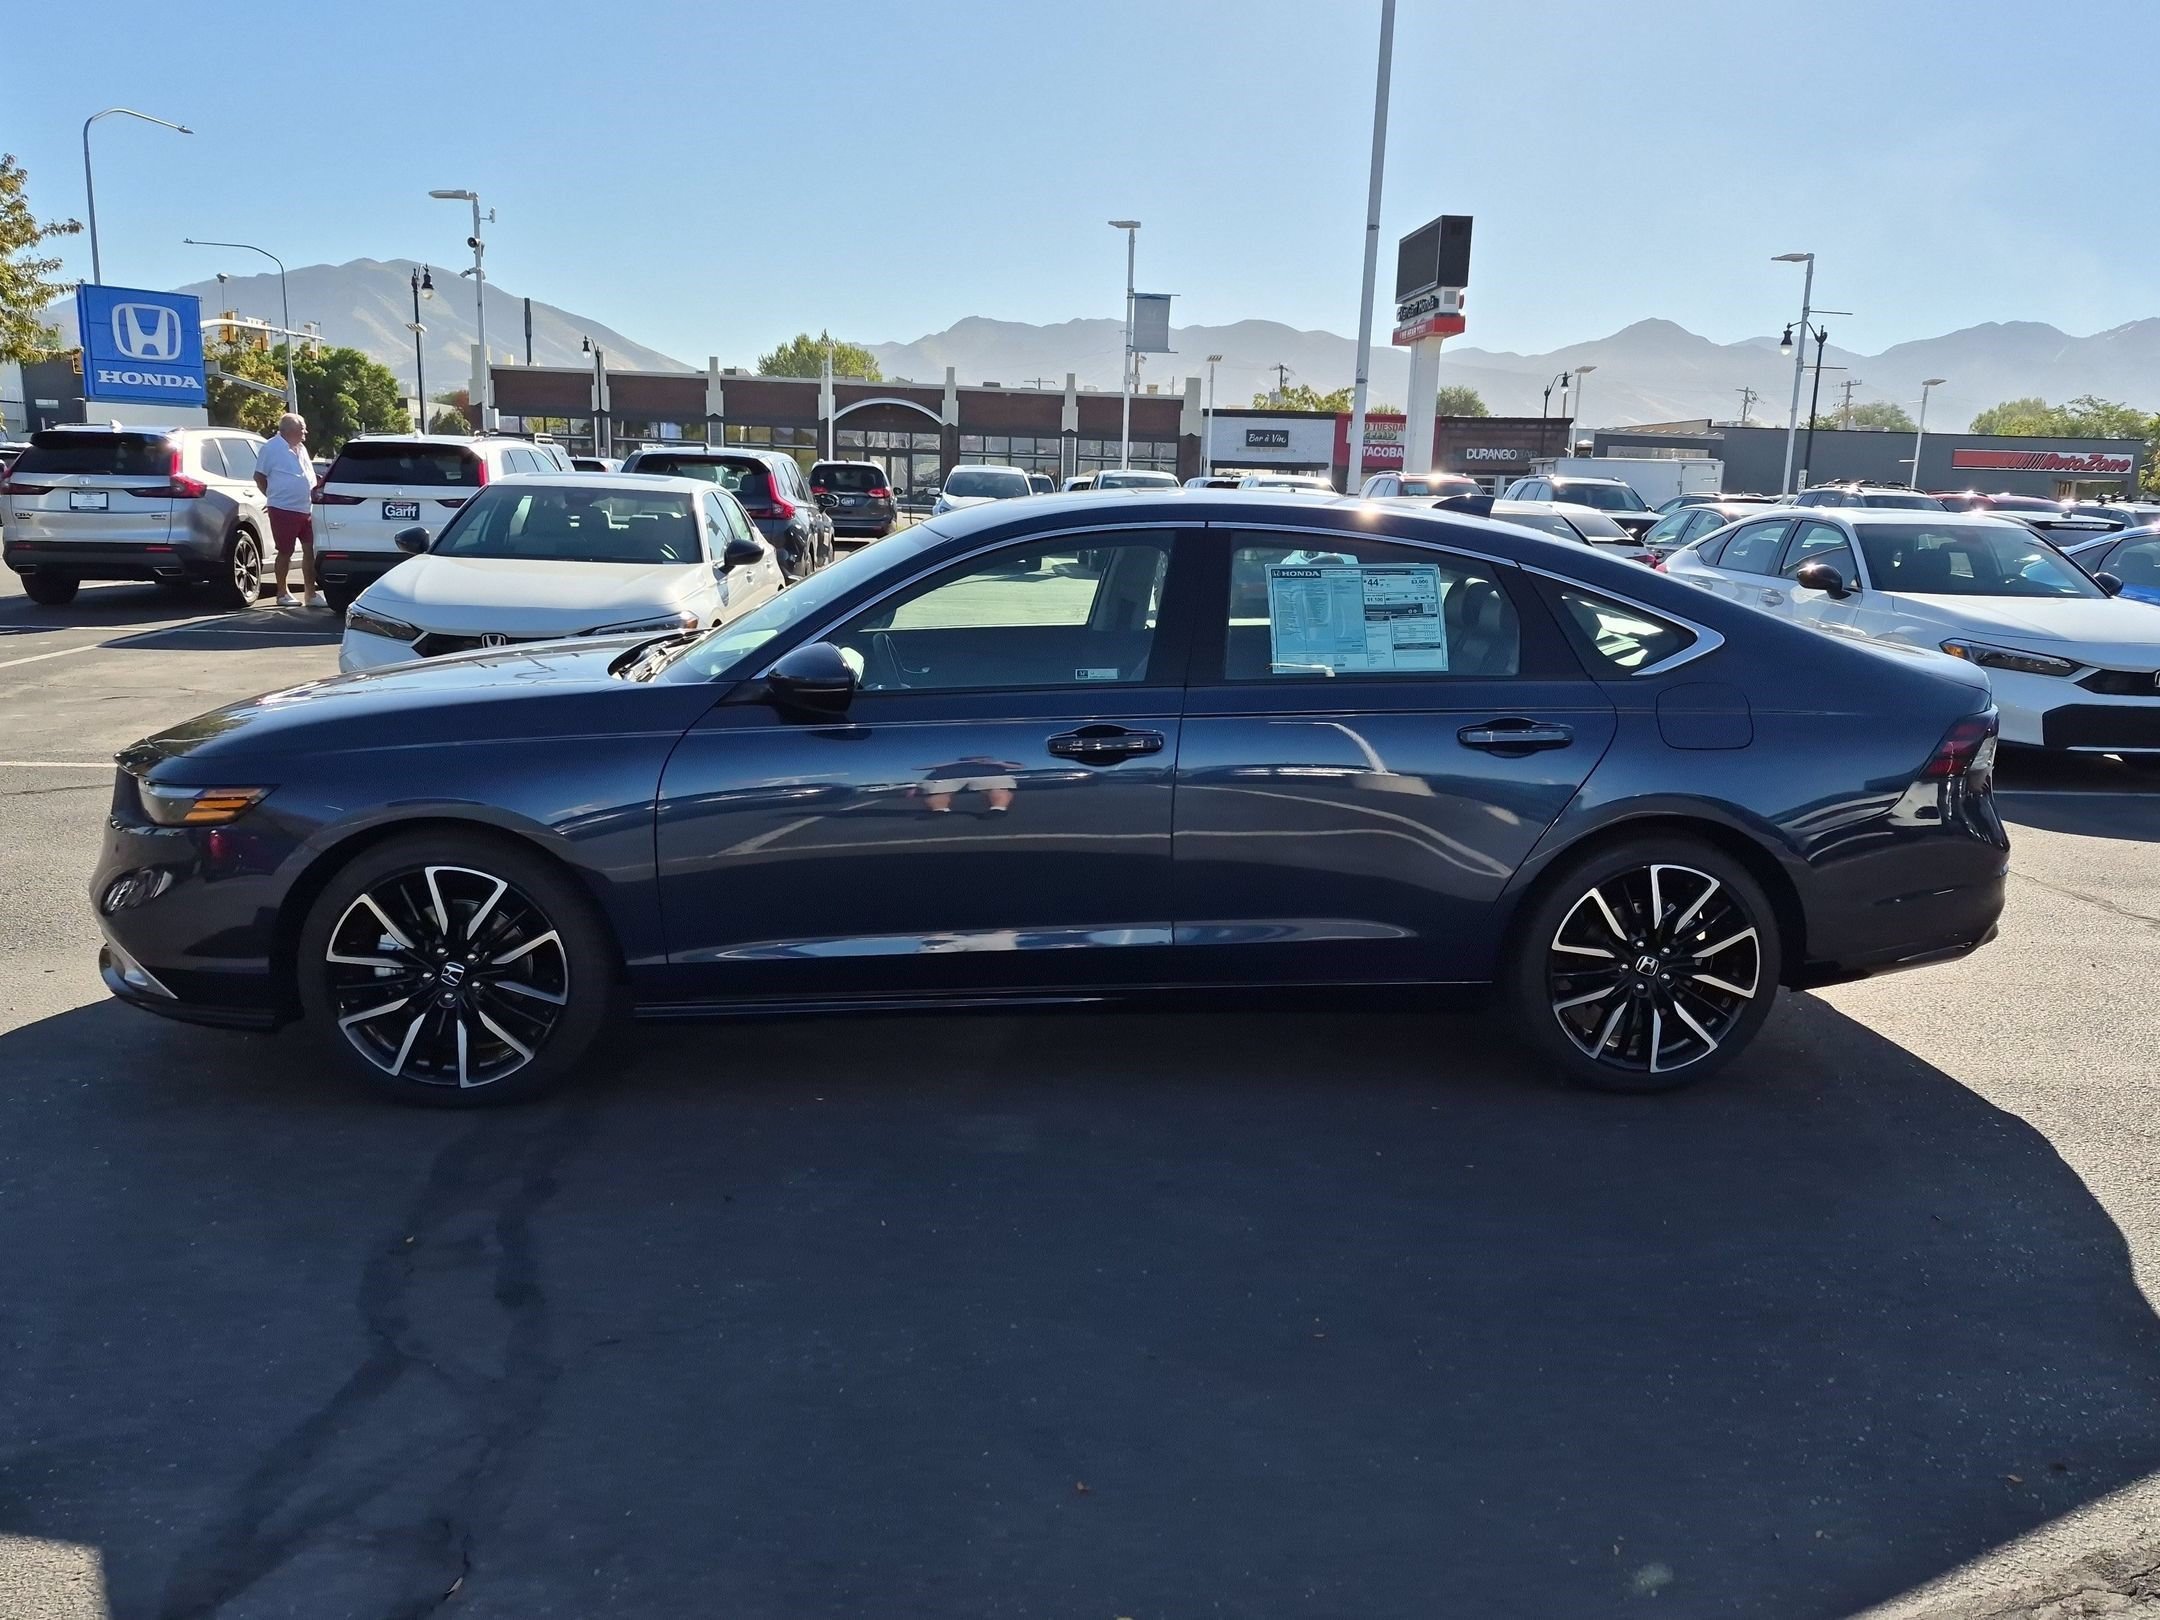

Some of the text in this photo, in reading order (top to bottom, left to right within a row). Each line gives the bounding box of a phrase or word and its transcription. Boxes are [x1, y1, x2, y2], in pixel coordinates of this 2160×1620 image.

[97, 370, 202, 389] HONDA
[1248, 433, 1263, 443] Bar
[1272, 434, 1287, 443] Vin
[1466, 448, 1517, 460] DURANGO
[2041, 453, 2131, 472] AutoZone
[384, 505, 417, 517] Garff
[1367, 579, 1379, 587] 44
